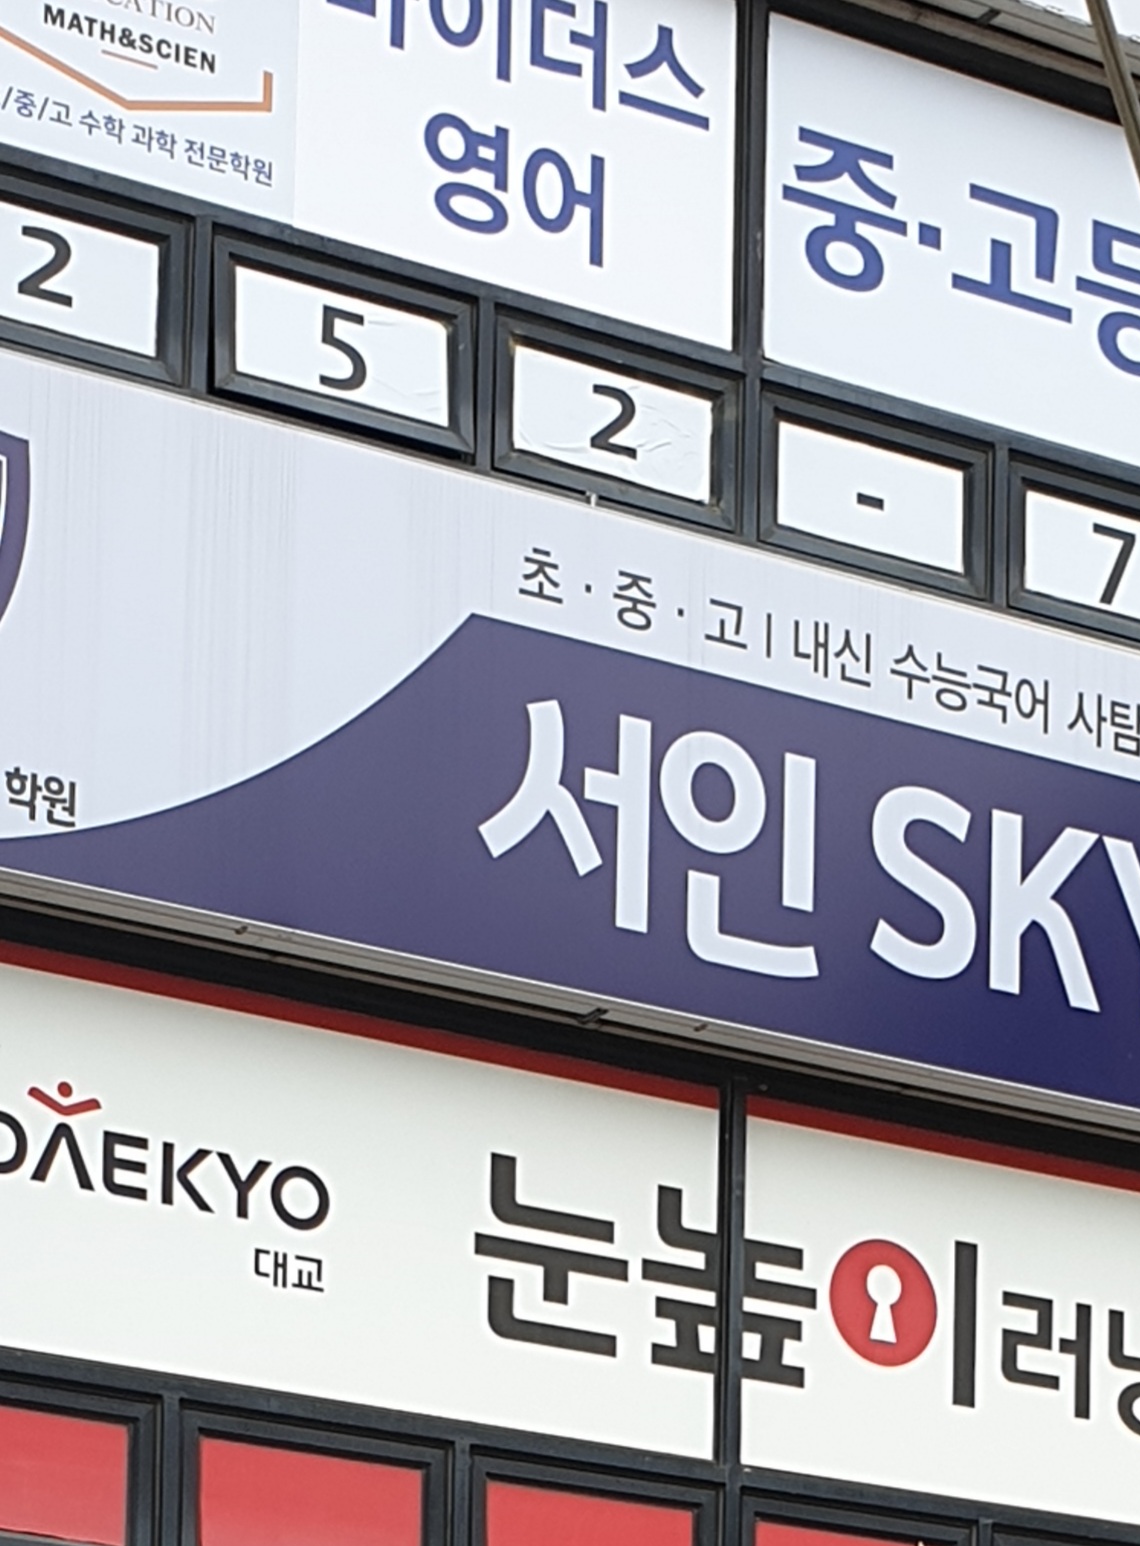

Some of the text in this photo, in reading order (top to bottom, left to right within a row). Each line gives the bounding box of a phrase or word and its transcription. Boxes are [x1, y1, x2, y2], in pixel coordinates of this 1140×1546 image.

[43, 3, 216, 74] MATH&SCIEN
[79, 110, 126, 144] 수학
[131, 124, 178, 159] 과학
[184, 138, 274, 188] 전문학원
[424, 113, 604, 267] 영어
[18, 225, 73, 308] 2
[318, 304, 367, 391] 5
[589, 384, 638, 460] 2
[1092, 523, 1136, 605] 7
[793, 619, 873, 688] 내신
[889, 644, 1050, 734] 수능국어
[5, 767, 77, 828] 학원
[478, 699, 819, 978] 서인
[254, 1248, 324, 1292] 대교
